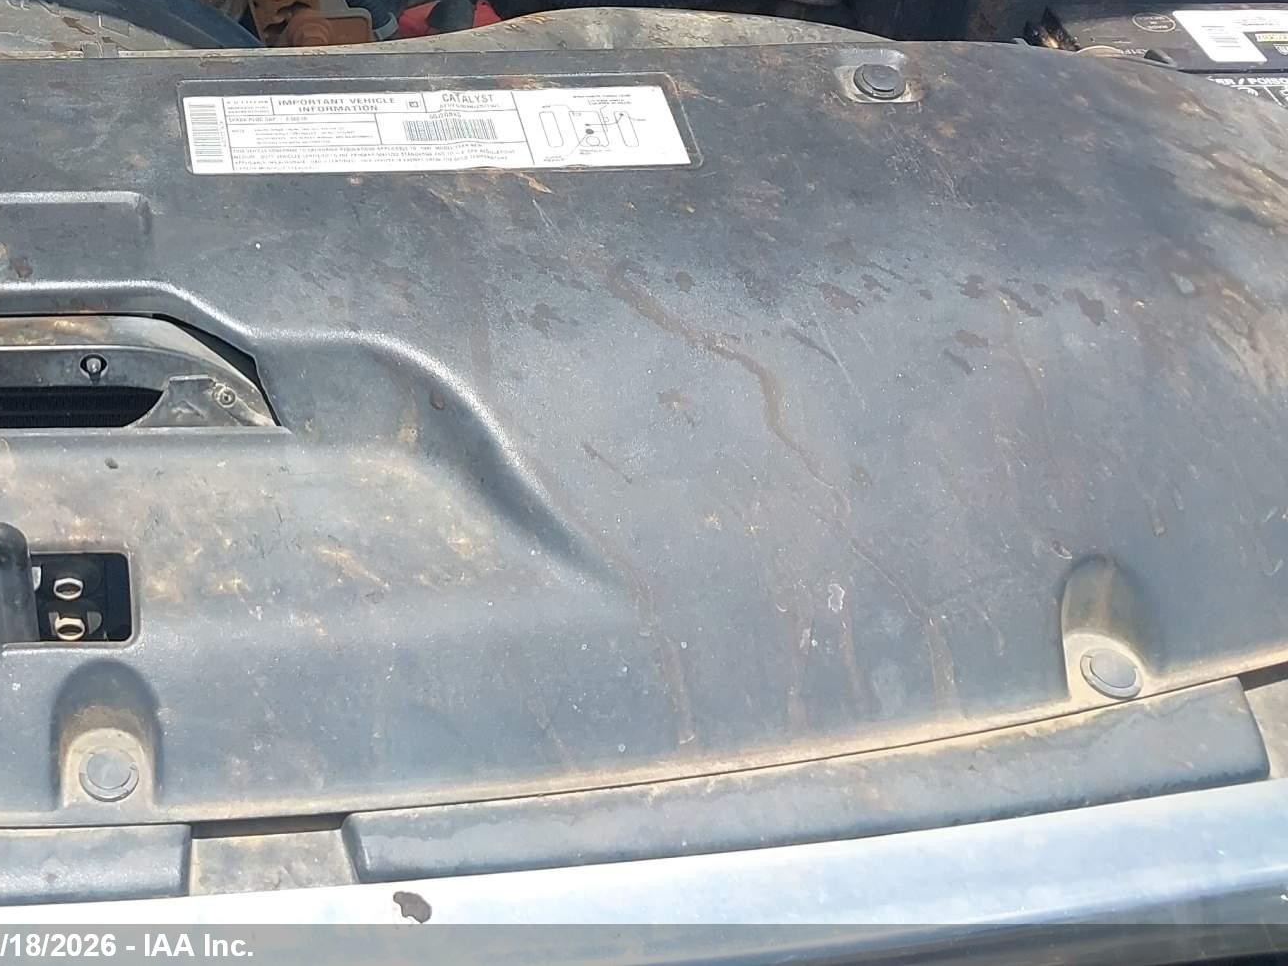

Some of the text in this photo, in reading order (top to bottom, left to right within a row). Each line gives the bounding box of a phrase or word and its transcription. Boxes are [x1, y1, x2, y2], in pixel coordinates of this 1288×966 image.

[278, 97, 348, 107] IMPORTANT
[351, 96, 396, 105] VEHICLE
[441, 92, 494, 104] CATALYST
[299, 104, 379, 112] INFORMATION
